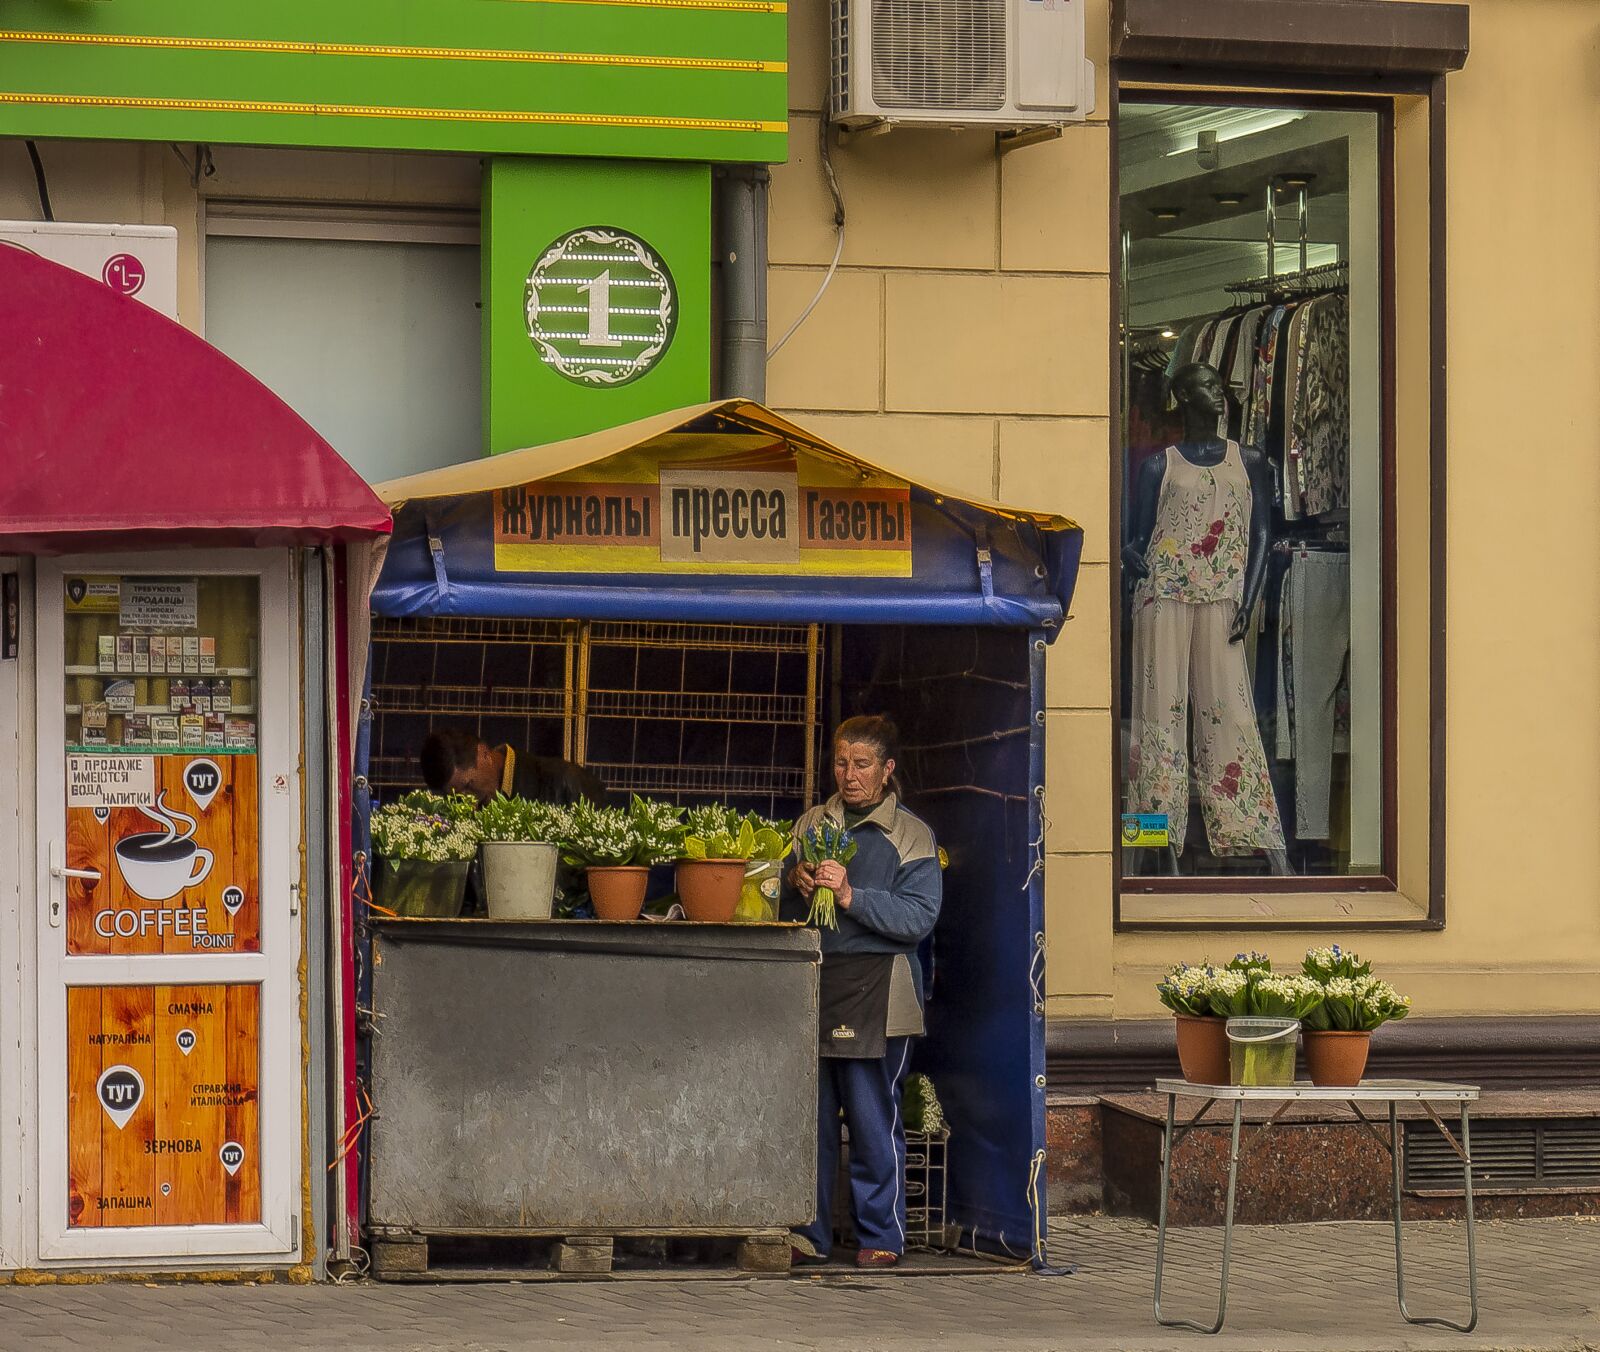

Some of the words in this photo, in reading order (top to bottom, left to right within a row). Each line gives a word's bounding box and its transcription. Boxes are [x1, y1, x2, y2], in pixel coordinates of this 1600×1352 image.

[577, 269, 621, 346] 1
[501, 487, 651, 540] Журналы
[672, 488, 787, 552] пресса
[807, 491, 905, 542] Газеты
[131, 596, 185, 606] ПРОДАВЦЫ
[71, 760, 78, 771] В
[85, 760, 142, 771] ПРОДАЖЕ
[73, 772, 129, 783] ИМЕЮТСЯ
[71, 784, 103, 796] ВОДА
[103, 792, 151, 804] НАПИТКИ
[94, 908, 208, 937] COFFEE
[192, 934, 235, 948] POINT
[168, 1003, 213, 1014] СМАЧНА
[89, 1034, 151, 1044] НАТУРАЛЬНА
[193, 1084, 241, 1094] СПРАВЖНЯ
[144, 1139, 202, 1153] ЗЕРНОВА
[96, 1196, 152, 1209] ЗАПАШНА
